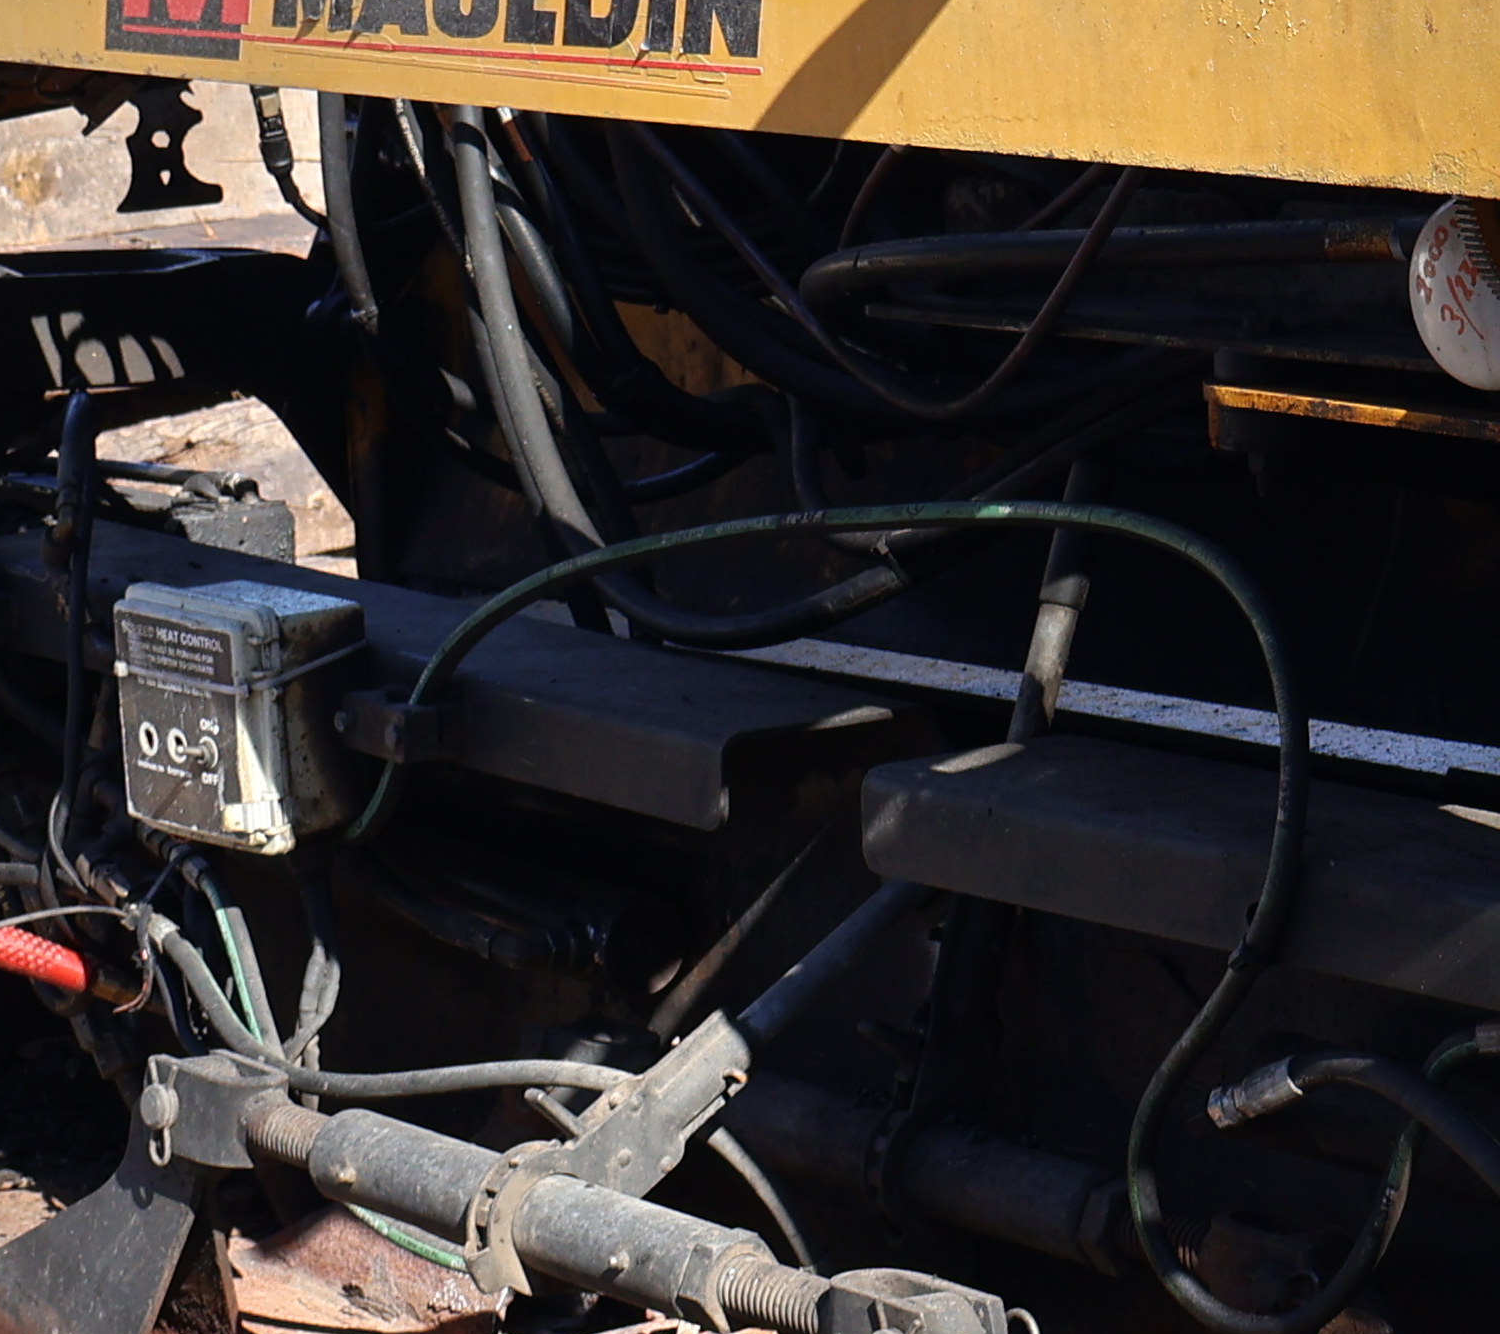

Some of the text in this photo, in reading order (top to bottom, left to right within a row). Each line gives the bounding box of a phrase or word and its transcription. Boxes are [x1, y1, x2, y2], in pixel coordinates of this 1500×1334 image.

[155, 626, 179, 644] HEAT
[180, 632, 224, 653] CONTROL
[201, 772, 219, 786] OFF
